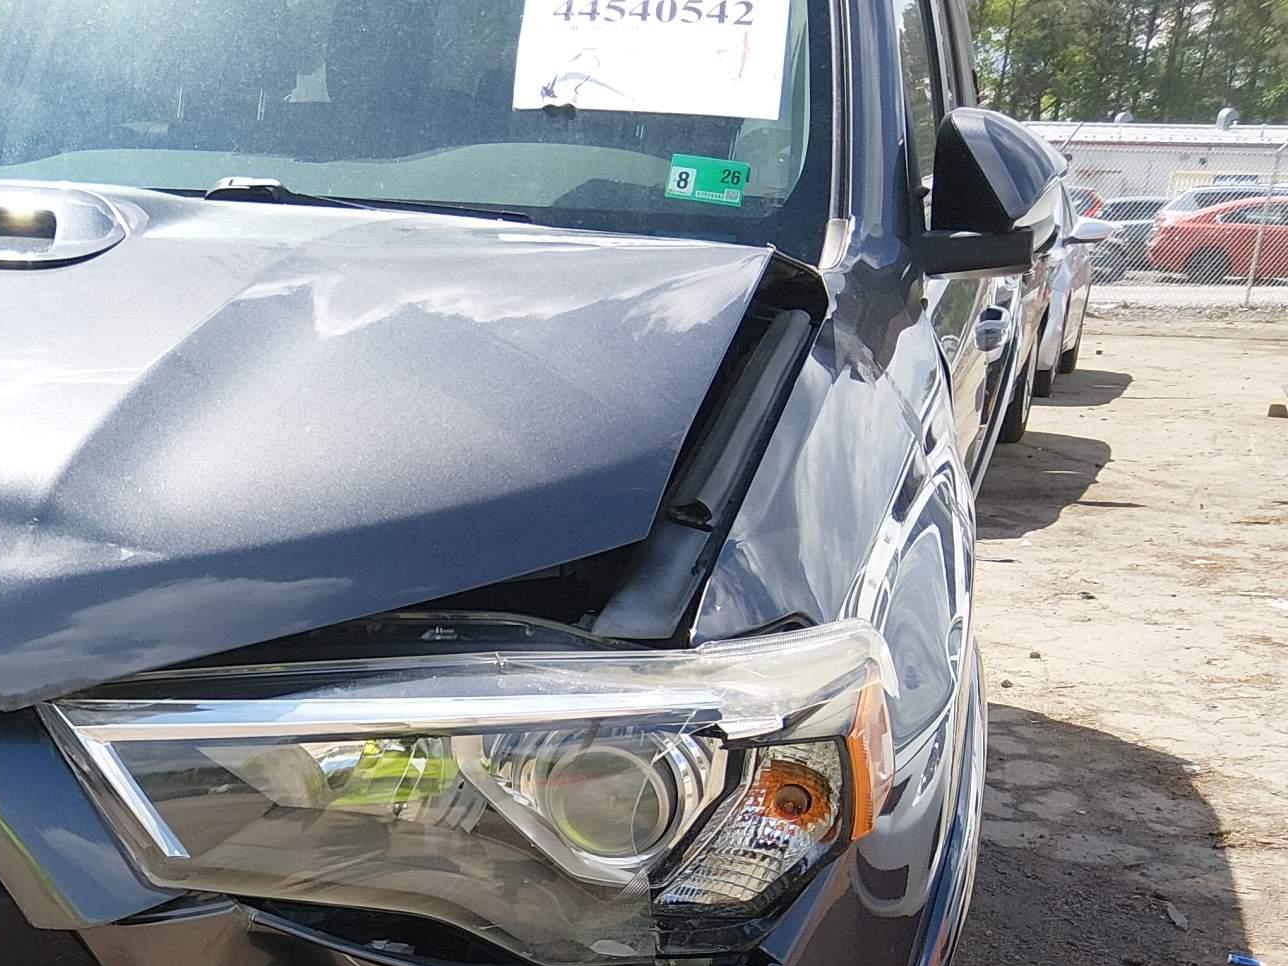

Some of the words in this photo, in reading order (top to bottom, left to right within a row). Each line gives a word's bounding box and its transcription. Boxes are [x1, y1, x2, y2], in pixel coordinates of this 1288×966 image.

[553, 0, 754, 25] 44540542
[676, 171, 690, 190] 8
[721, 169, 742, 185] 26
